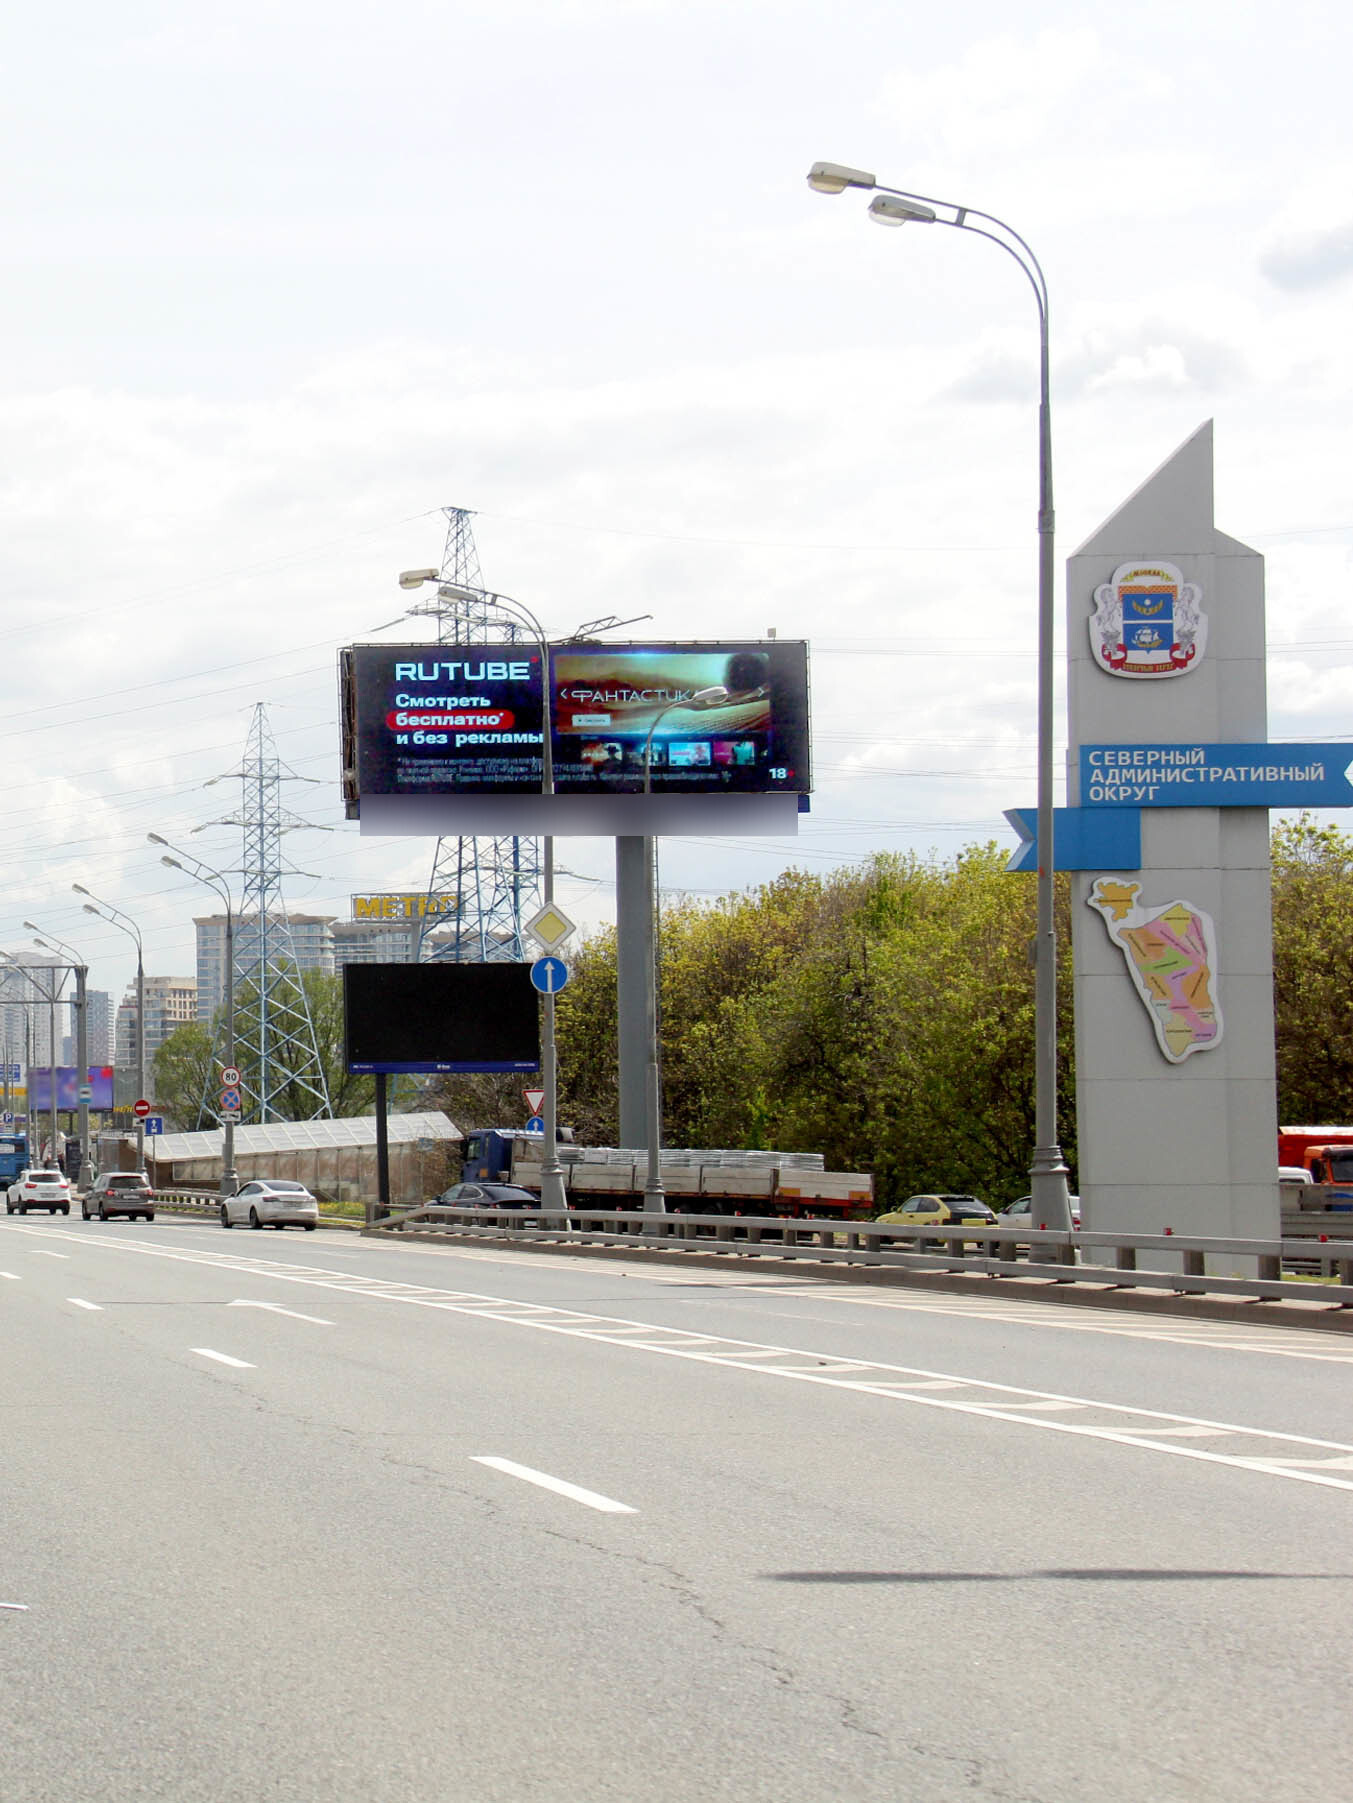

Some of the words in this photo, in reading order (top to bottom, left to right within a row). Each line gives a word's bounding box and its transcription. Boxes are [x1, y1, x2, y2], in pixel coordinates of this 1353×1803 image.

[395, 661, 530, 681] RUTUBE
[395, 693, 491, 710] Смотреть
[571, 688, 696, 703] ФАНТАСТИК
[396, 733, 408, 745] и
[412, 730, 448, 745] без
[455, 732, 544, 748] рекламы
[1088, 748, 1205, 767] СЕВЕРНЫЙ
[1089, 763, 1325, 785] АДМИНИСТРАТИВНЫЙ
[1088, 785, 1160, 802] ОКРУГ
[225, 1072, 237, 1081] 80
